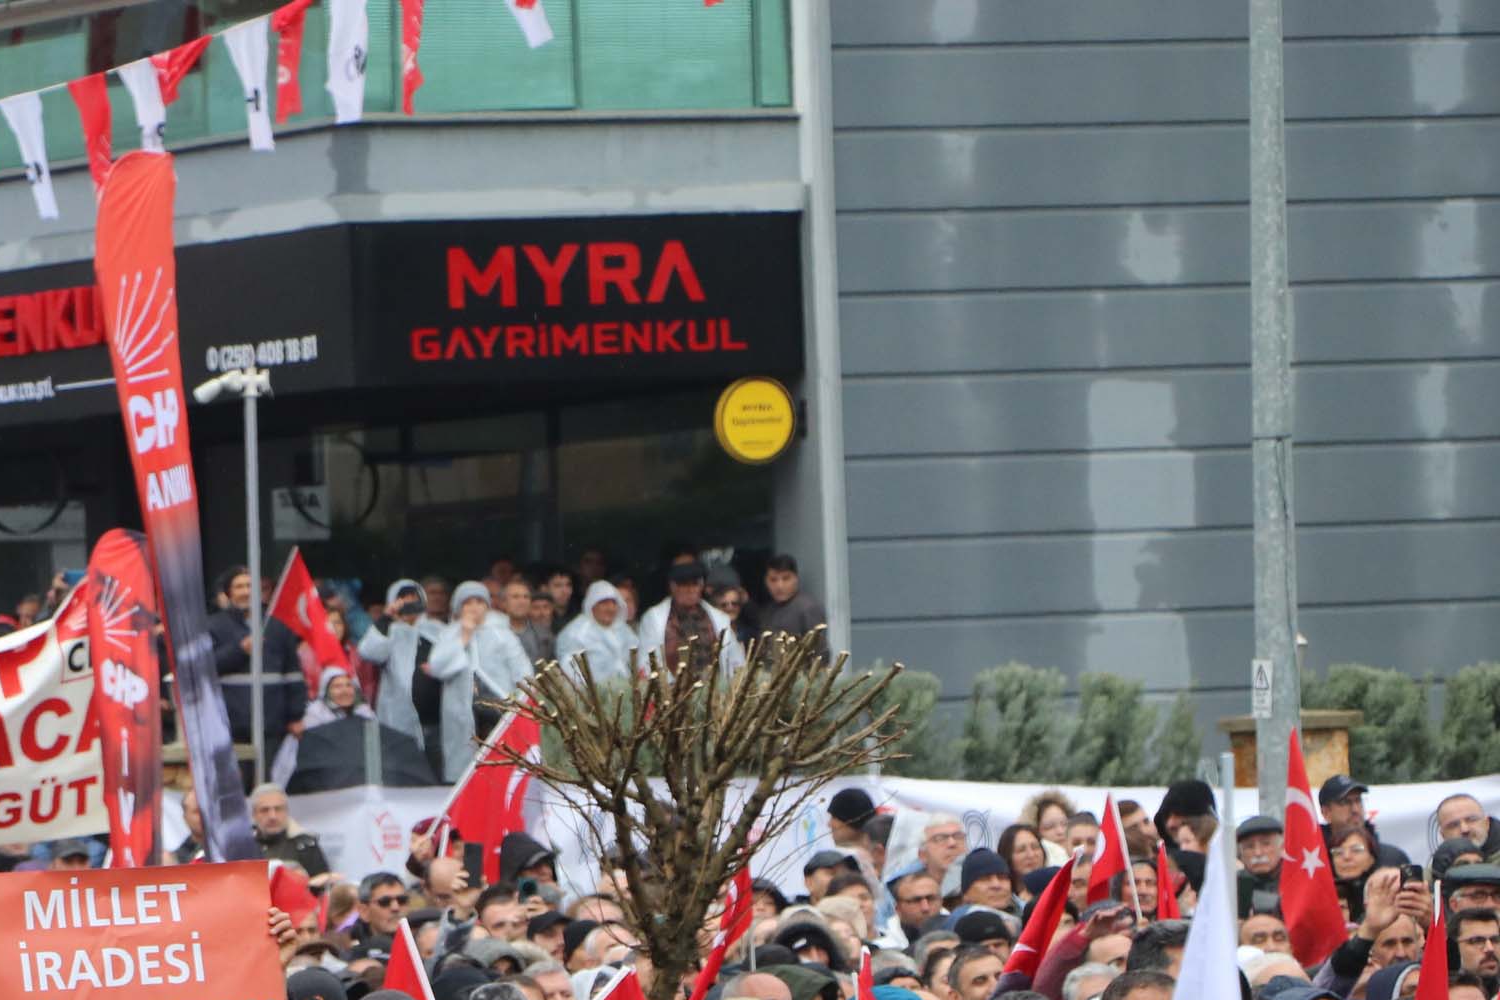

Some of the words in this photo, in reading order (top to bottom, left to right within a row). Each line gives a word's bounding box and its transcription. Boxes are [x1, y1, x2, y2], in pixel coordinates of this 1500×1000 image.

[446, 240, 706, 309] MYRA
[411, 318, 748, 361] GAYRİMENKUL
[23, 876, 188, 931] MİLLET
[18, 931, 205, 992] İRADESİ
